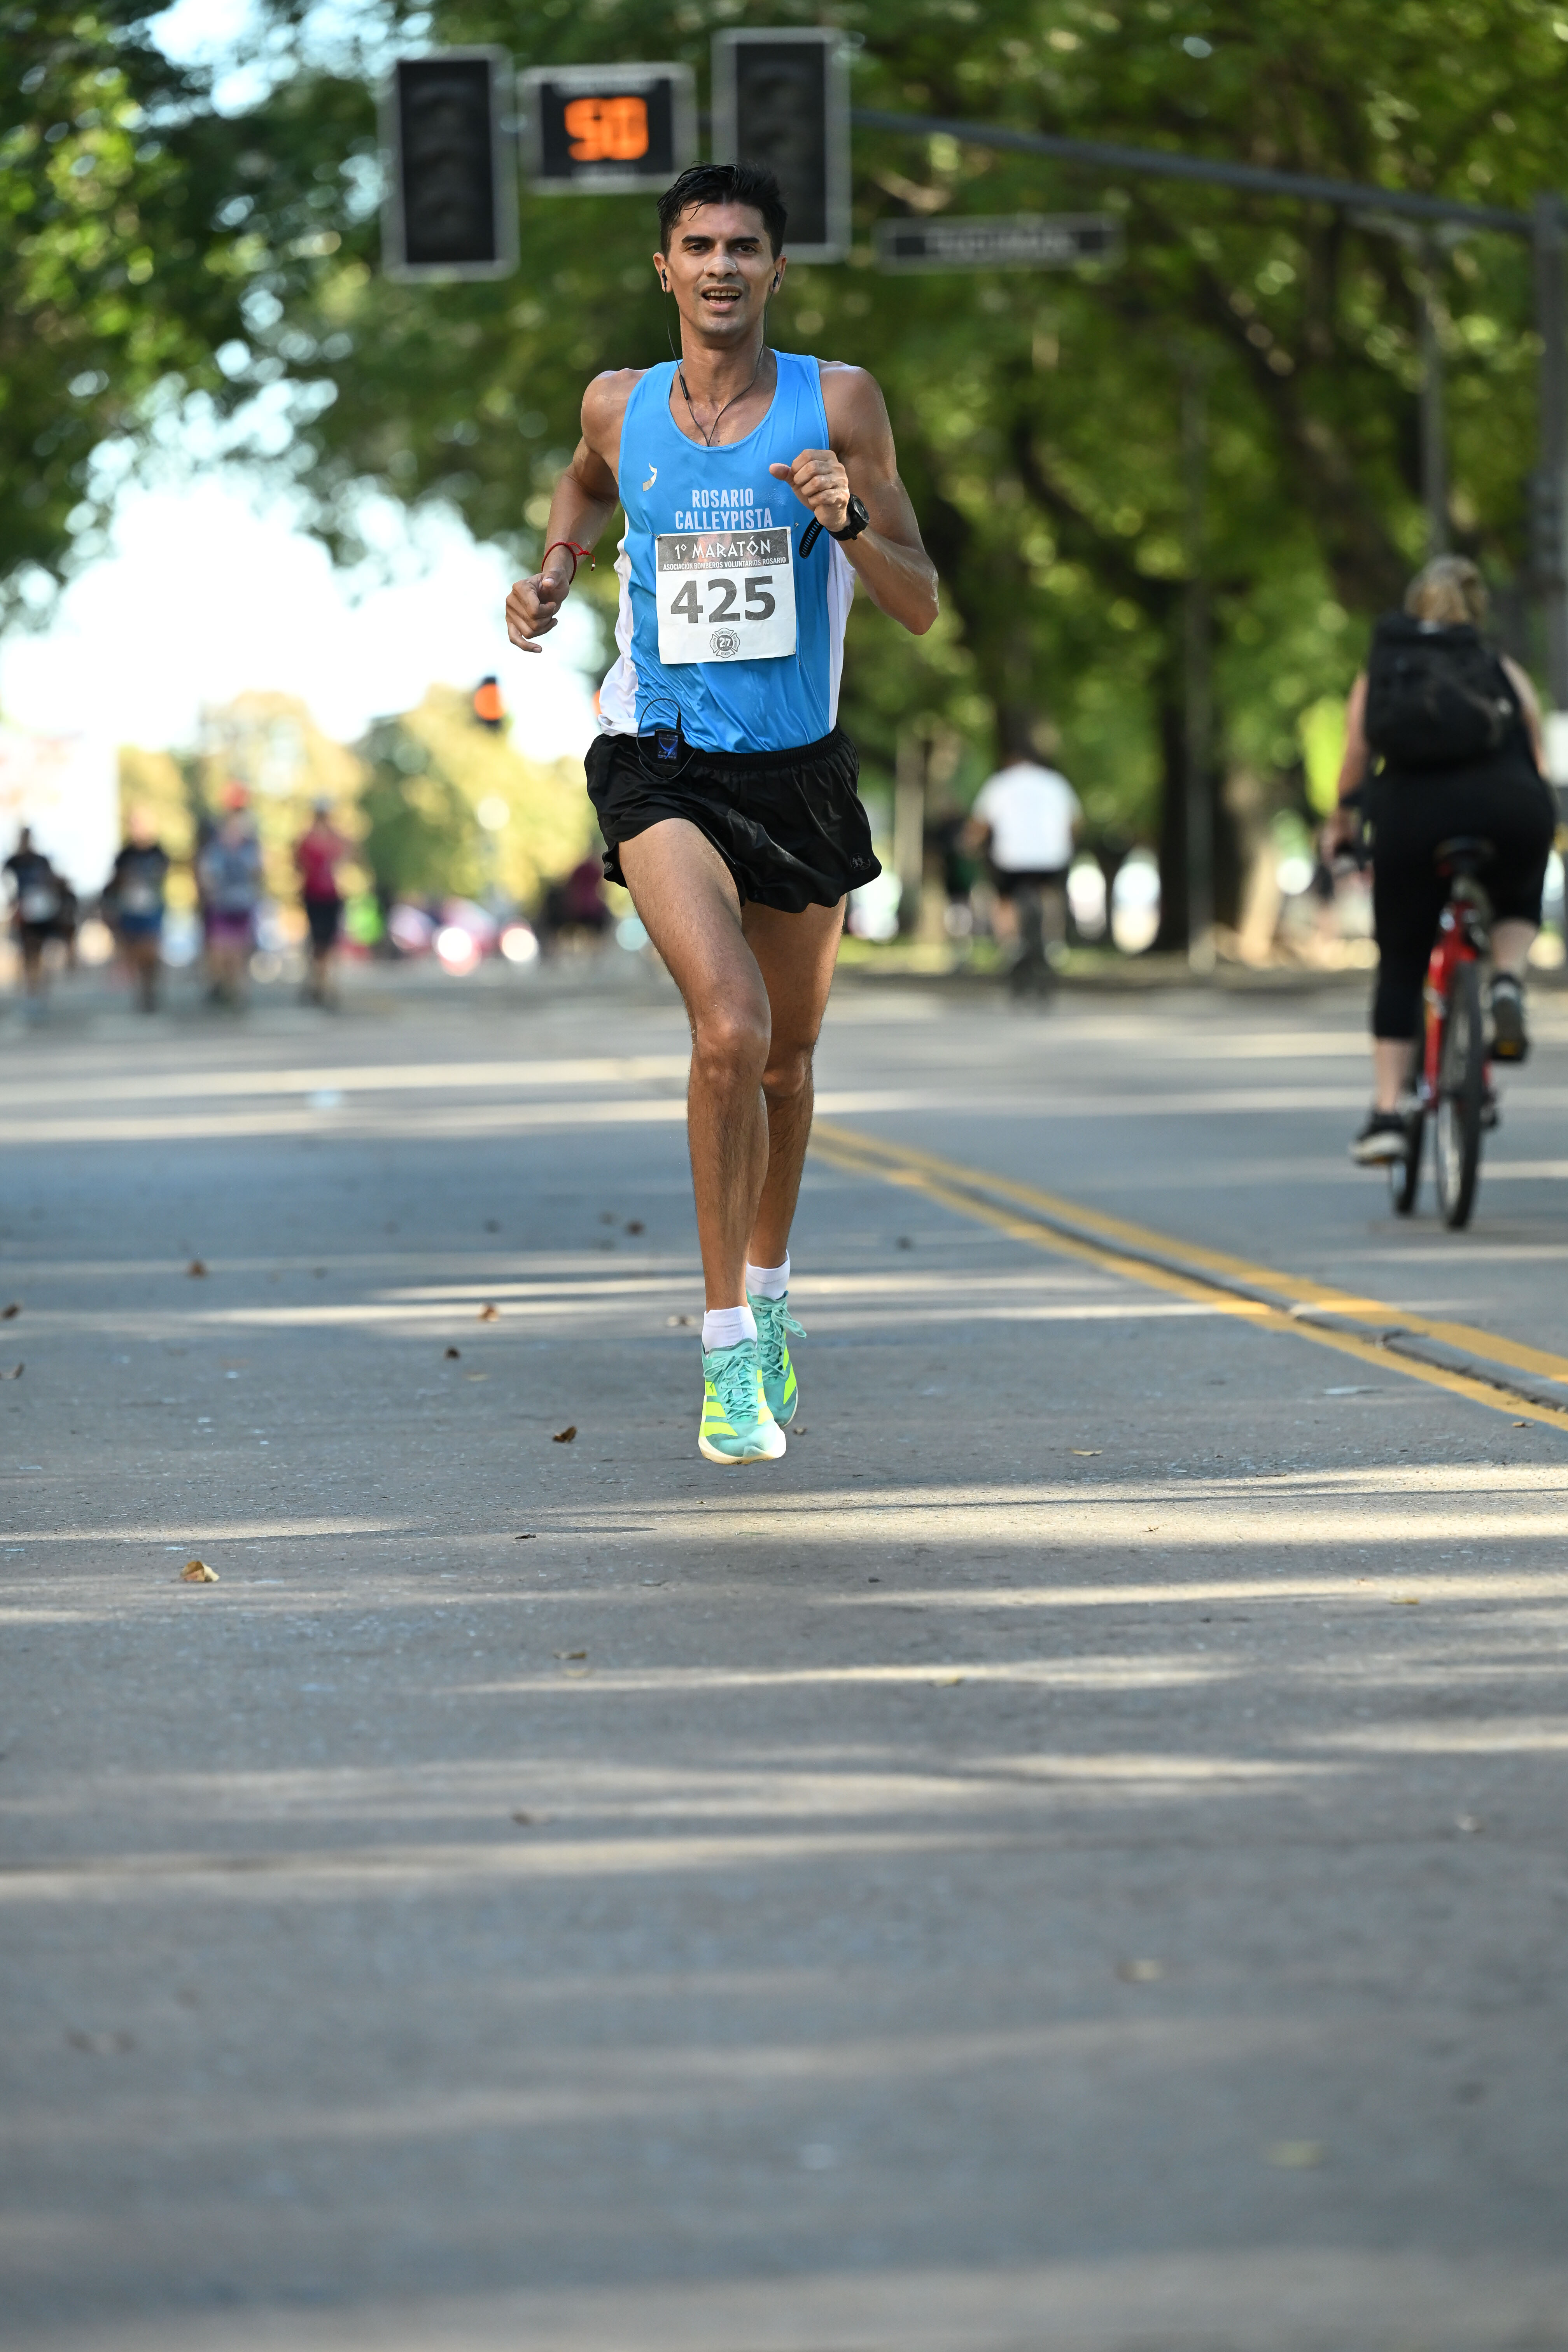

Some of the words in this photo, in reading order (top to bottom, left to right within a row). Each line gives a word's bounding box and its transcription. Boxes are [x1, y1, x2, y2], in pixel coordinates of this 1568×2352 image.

[692, 488, 754, 508] ROSARIO
[675, 508, 773, 530] CALLEYPISTA
[692, 536, 771, 559] MARATÓN
[663, 562, 693, 570] ASOCIACIÓN
[724, 559, 761, 568] VOLUNTARIOS
[762, 556, 786, 565] ROSARIO
[670, 575, 775, 623] 425
[719, 637, 731, 648] 27
